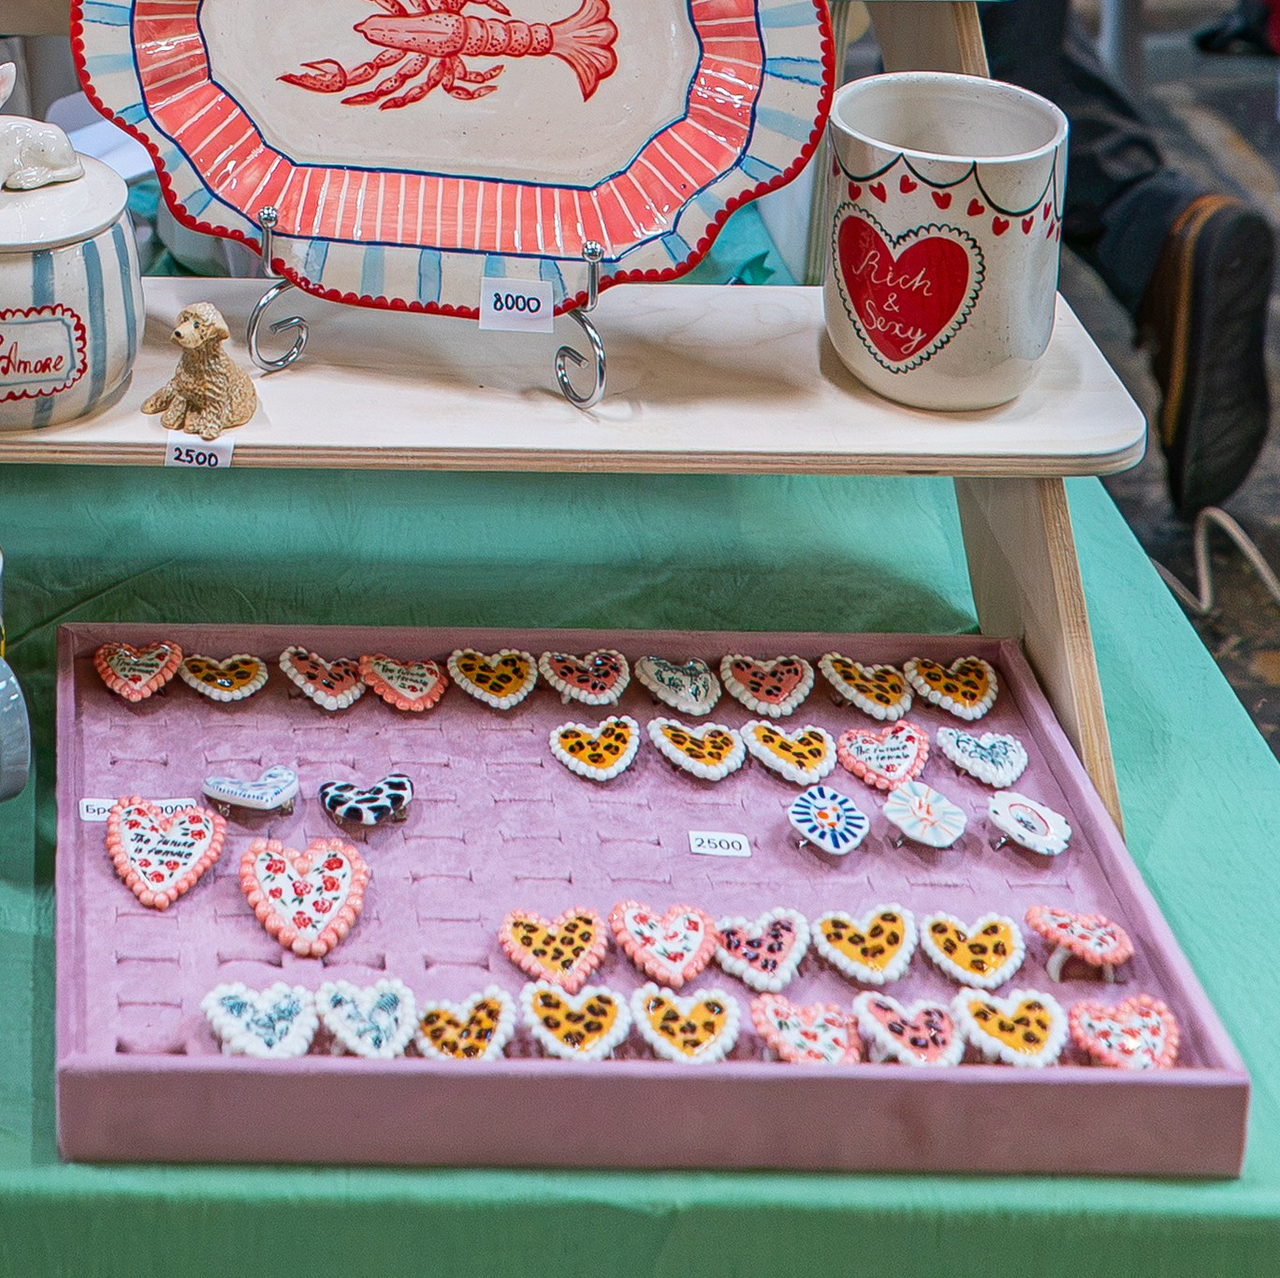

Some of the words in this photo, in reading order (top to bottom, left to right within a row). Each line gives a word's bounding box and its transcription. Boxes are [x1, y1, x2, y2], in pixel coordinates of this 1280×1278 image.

[851, 250, 933, 297] Rich
[492, 292, 541, 313] 8000
[883, 293, 900, 312] &
[862, 299, 928, 355] Sexy
[173, 447, 218, 467] 2500
[694, 837, 743, 851] 2500
